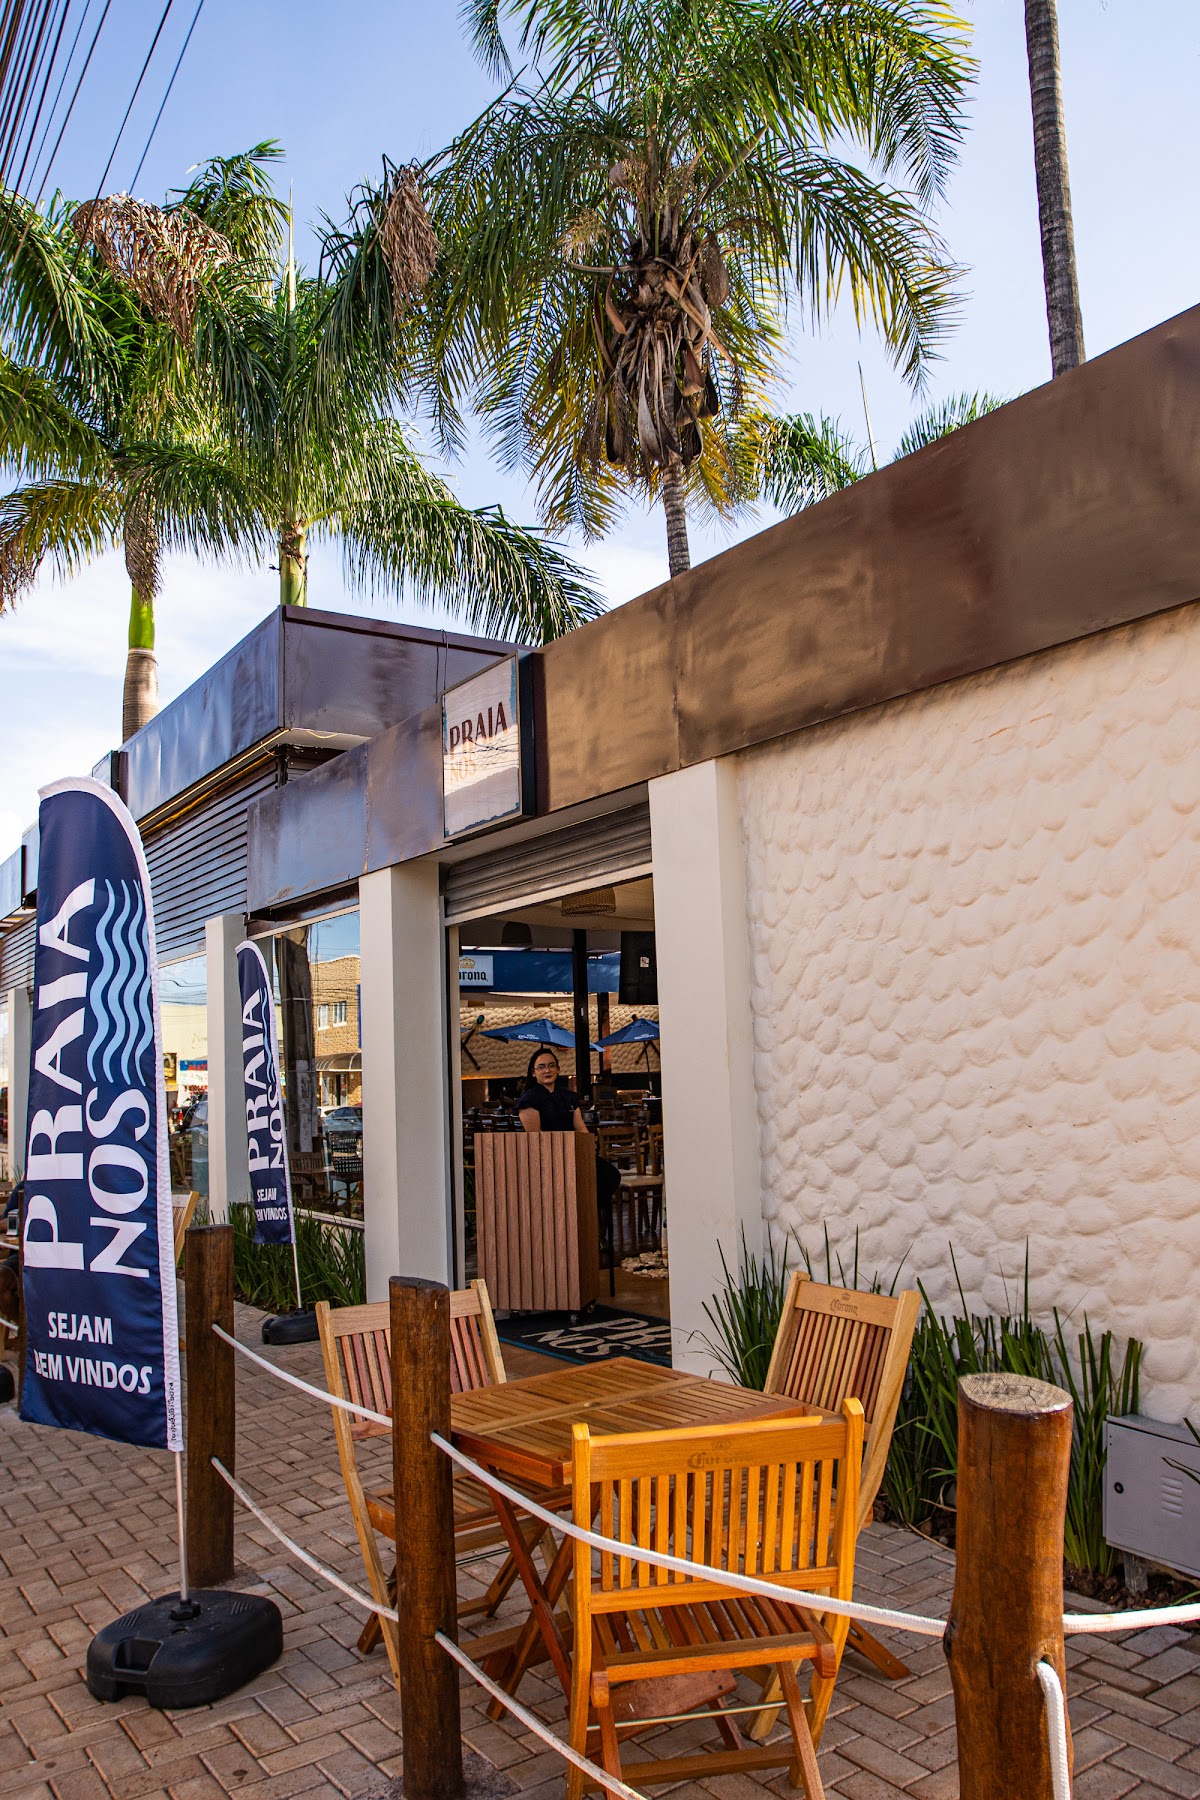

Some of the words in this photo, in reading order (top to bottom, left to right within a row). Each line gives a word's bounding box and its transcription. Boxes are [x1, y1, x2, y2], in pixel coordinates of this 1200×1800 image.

[449, 701, 508, 757] PRAIA
[450, 753, 477, 782] NOS
[23, 877, 96, 1271] PRAIA
[243, 988, 270, 1173] PRAIA
[85, 1087, 150, 1278] NOS
[256, 1187, 277, 1202] SEJAM
[263, 1206, 288, 1221] VINDOS
[48, 1311, 113, 1345] SEJAM
[65, 1355, 153, 1395] VINDOS
